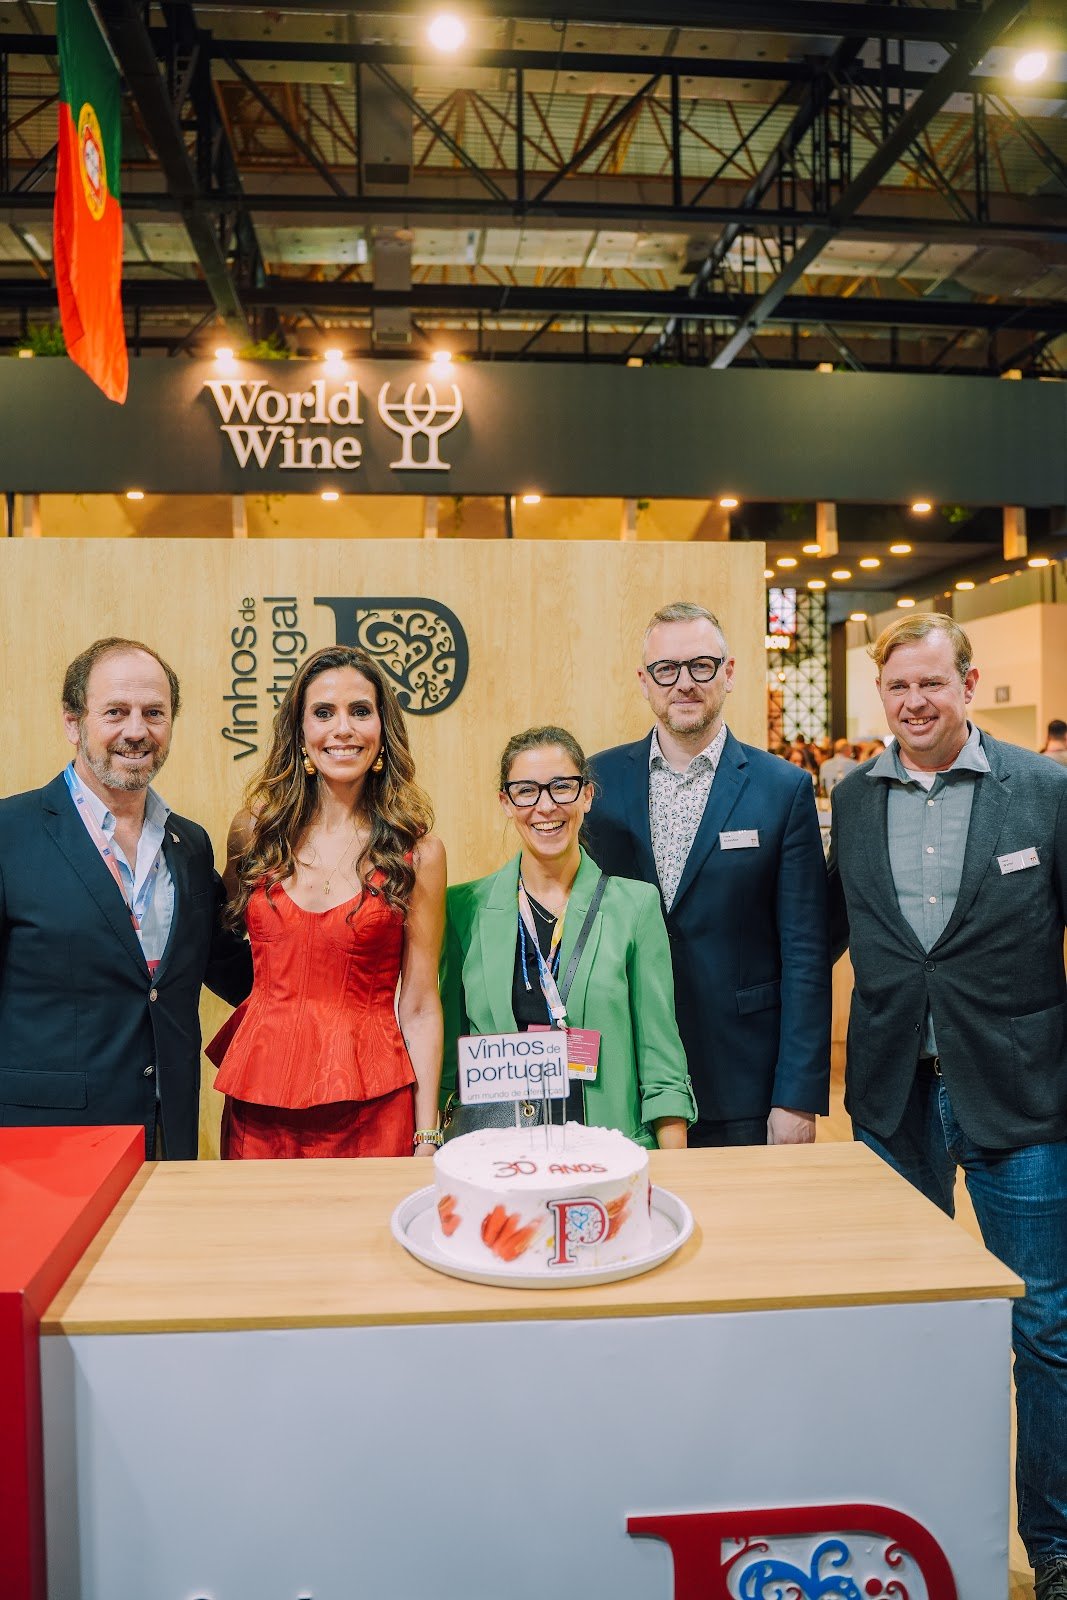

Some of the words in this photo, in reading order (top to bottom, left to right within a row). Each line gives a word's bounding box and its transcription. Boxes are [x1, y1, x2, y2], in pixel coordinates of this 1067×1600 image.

[203, 380, 364, 425] World
[220, 425, 363, 469] Wine
[237, 597, 256, 622] de
[263, 597, 307, 709] rtugal
[221, 625, 258, 761] Vinhos
[467, 1038, 545, 1060] Vinhos
[546, 1044, 561, 1054] de
[466, 1057, 563, 1088] portugal
[481, 1090, 510, 1099] mundo
[511, 1089, 521, 1097] de
[493, 1160, 537, 1178] 30
[548, 1162, 608, 1175] ANOS
